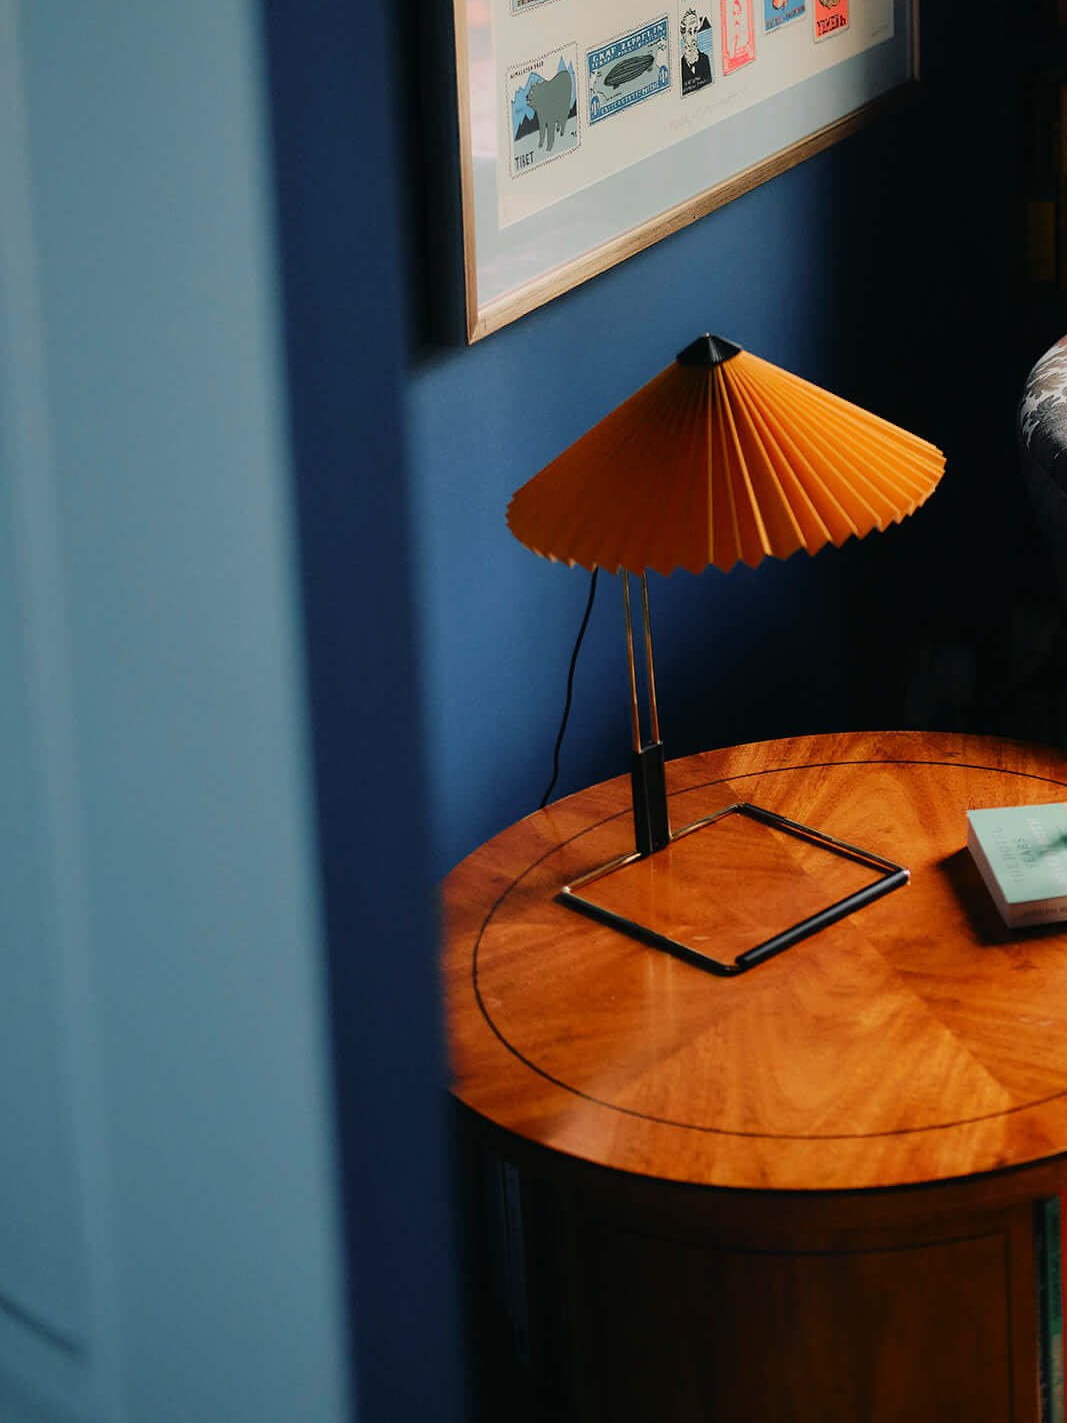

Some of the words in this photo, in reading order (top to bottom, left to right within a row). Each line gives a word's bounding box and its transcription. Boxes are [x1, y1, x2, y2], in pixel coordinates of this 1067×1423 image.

[592, 43, 616, 64] GRAF
[621, 24, 665, 54] ZEPPELIN
[515, 151, 534, 171] TIBET
